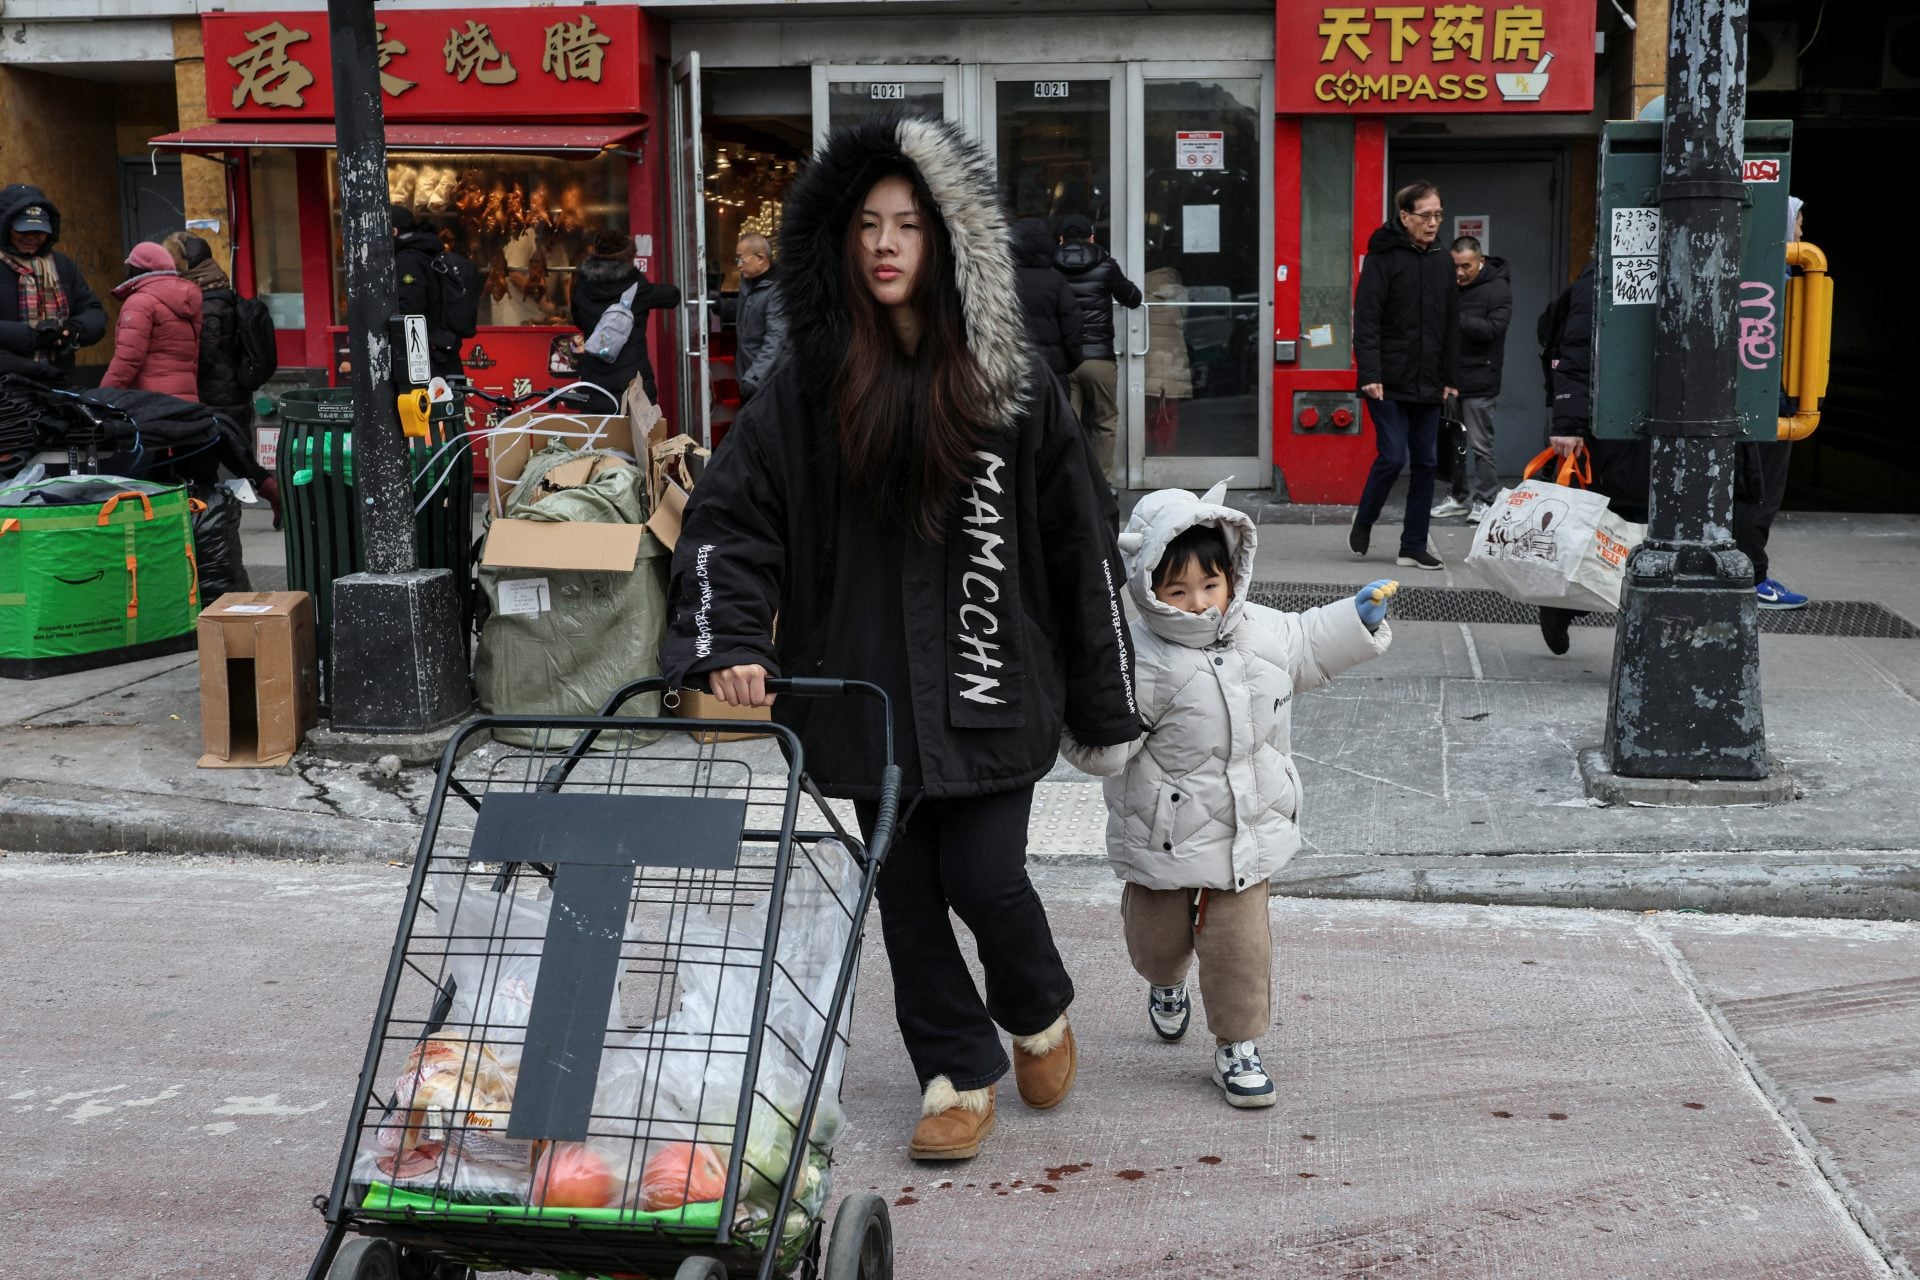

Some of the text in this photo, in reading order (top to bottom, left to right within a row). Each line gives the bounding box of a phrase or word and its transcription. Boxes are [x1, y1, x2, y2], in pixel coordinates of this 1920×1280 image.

[1318, 4, 1546, 62] 天下药房
[871, 84, 904, 98] 4021
[1035, 82, 1068, 97] 4021
[1315, 69, 1489, 104] COMPASS
[954, 450, 1007, 705] MAMCCHN
